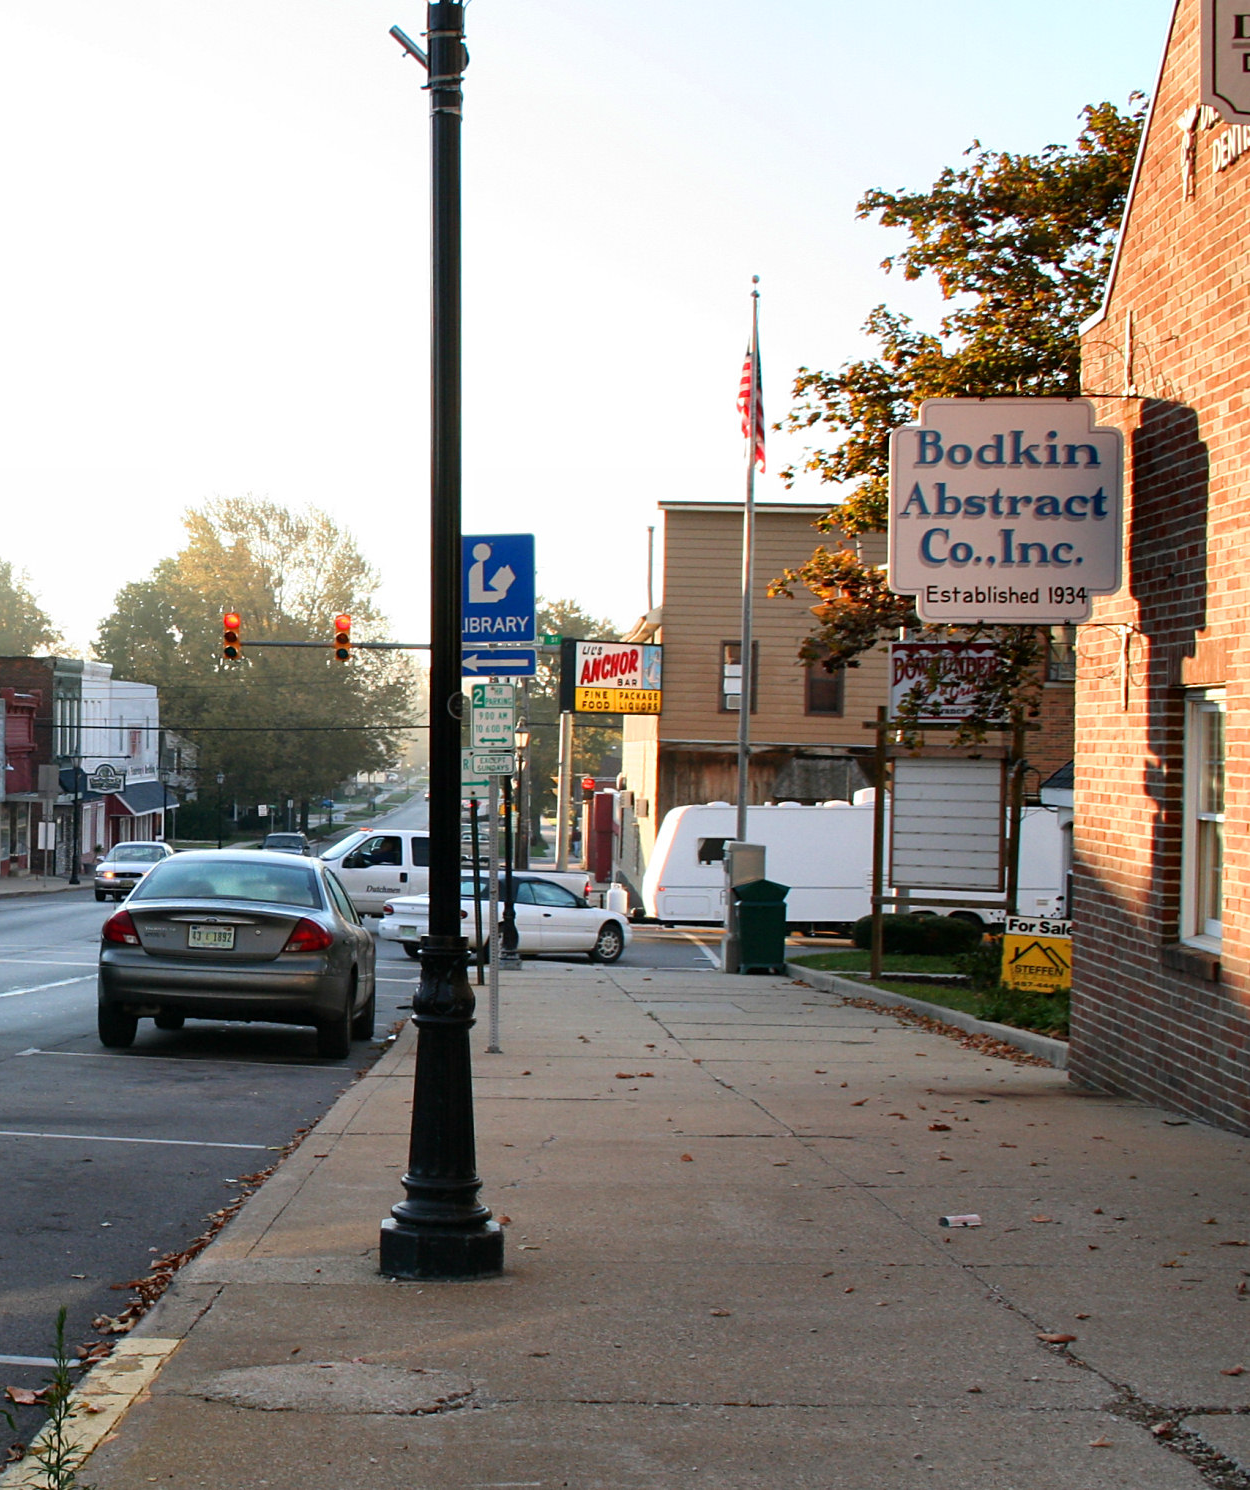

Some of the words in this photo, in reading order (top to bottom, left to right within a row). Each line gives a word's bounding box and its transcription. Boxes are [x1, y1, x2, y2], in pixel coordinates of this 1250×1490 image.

[915, 430, 1101, 467] Bodkin
[899, 481, 1109, 519] Abstract
[926, 585, 1039, 604] Established
[1049, 586, 1088, 605] 1934
[462, 616, 529, 634] IBRARY
[580, 649, 639, 685] ANCHOR
[617, 678, 638, 687] BAR
[473, 688, 483, 705] 2
[584, 690, 608, 699] FINE
[619, 691, 658, 701] PACKAGE
[582, 701, 610, 710] FOOD
[620, 702, 658, 711] LIQUORS
[498, 711, 509, 719] AM
[502, 724, 512, 733] PM
[366, 885, 401, 893] Dutchmen
[1008, 918, 1036, 932] For
[1039, 921, 1073, 936] Sale
[1015, 964, 1064, 977] STEFFEN
